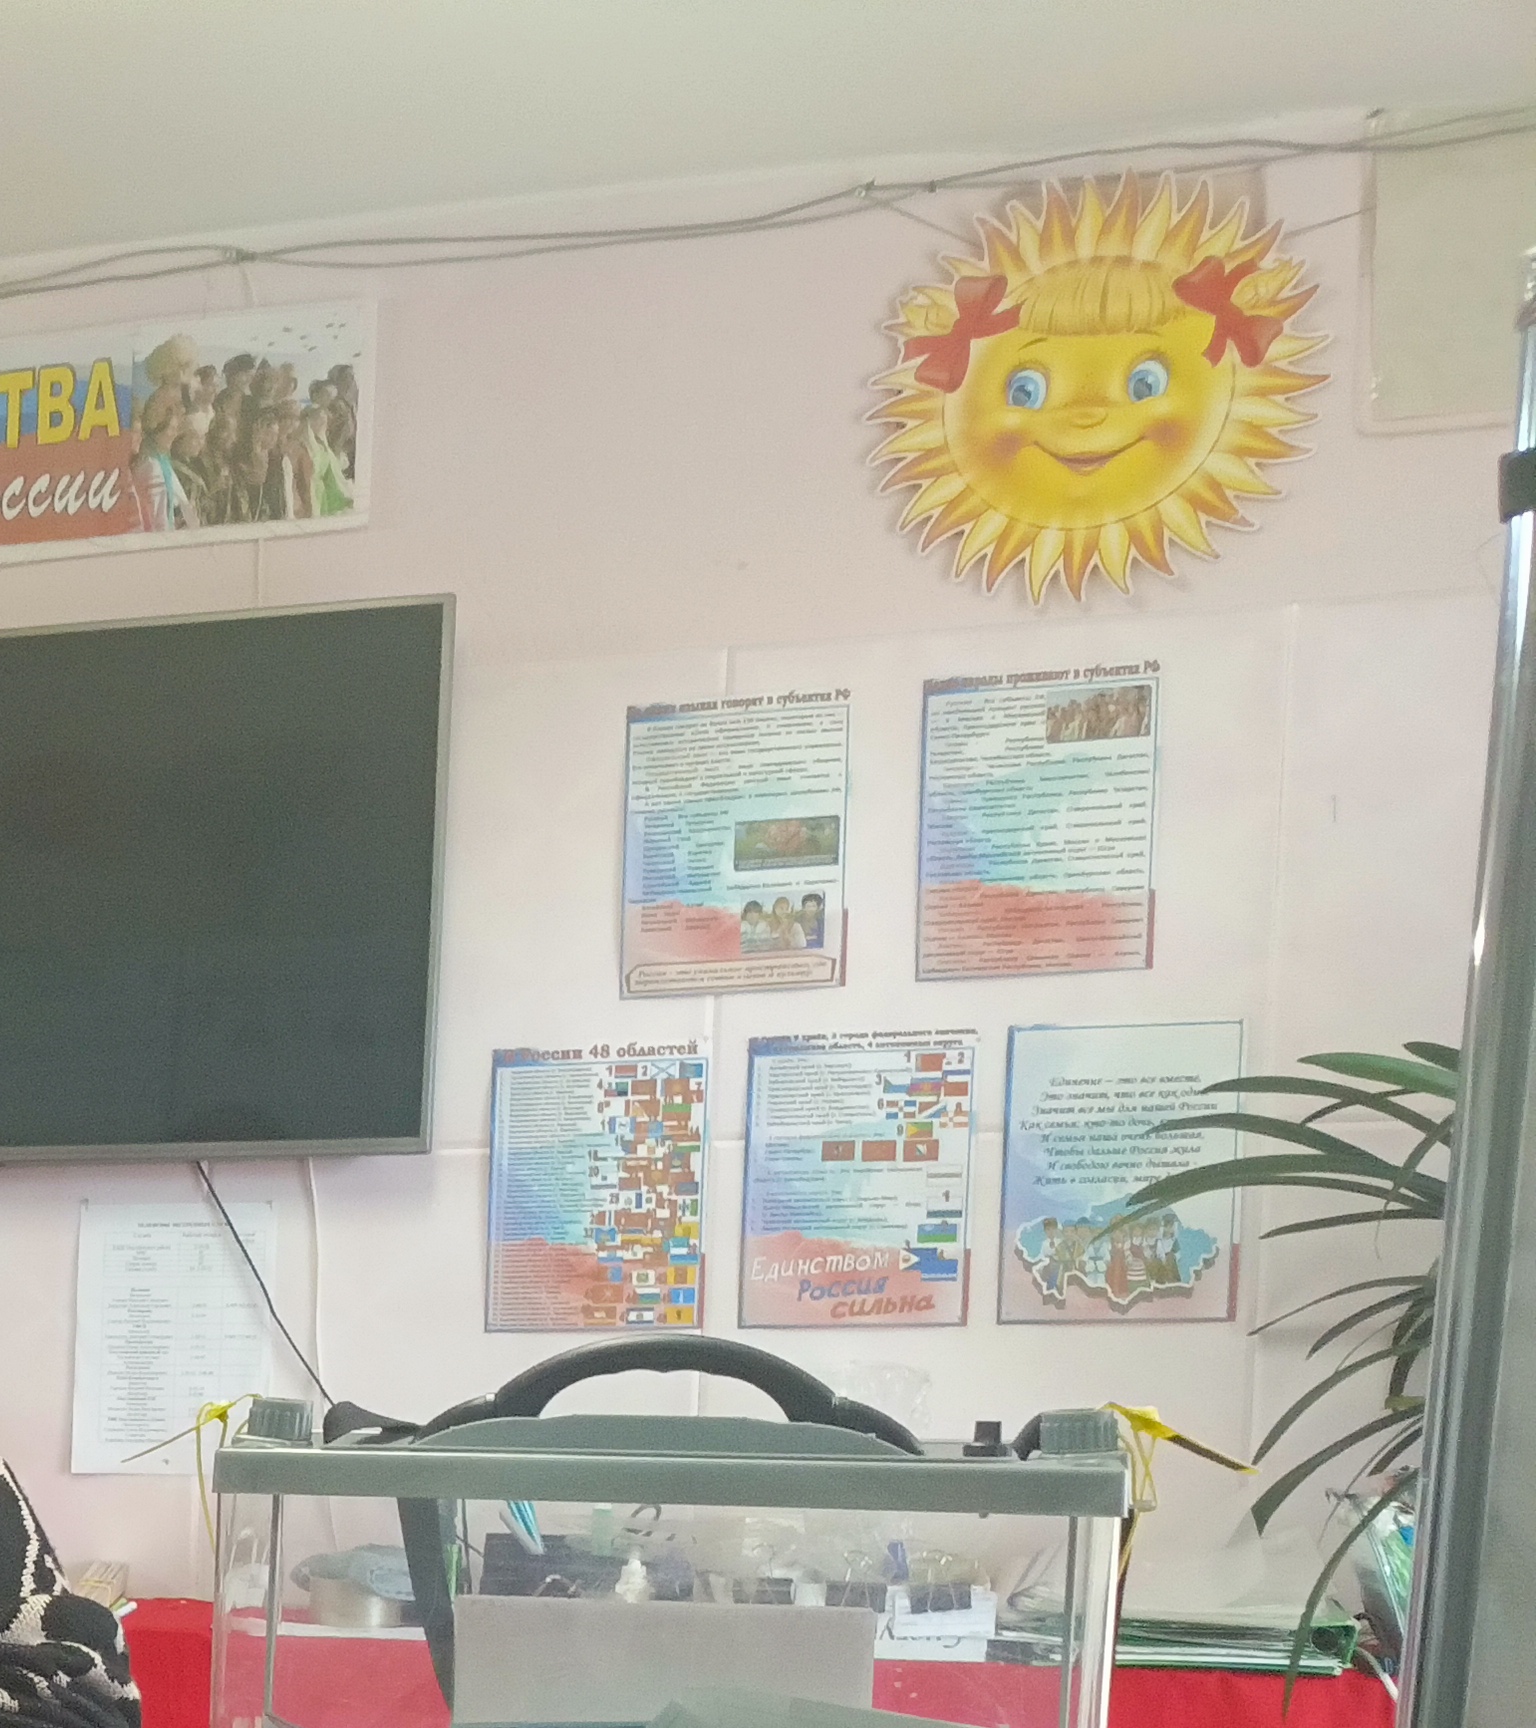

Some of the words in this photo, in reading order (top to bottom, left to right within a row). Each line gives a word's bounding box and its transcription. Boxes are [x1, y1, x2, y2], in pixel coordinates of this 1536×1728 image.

[589, 1043, 611, 1060] 48
[616, 1039, 699, 1059] областей
[750, 1249, 890, 1283] Единством
[796, 1276, 890, 1303] Россия
[830, 1293, 936, 1320] сильна
